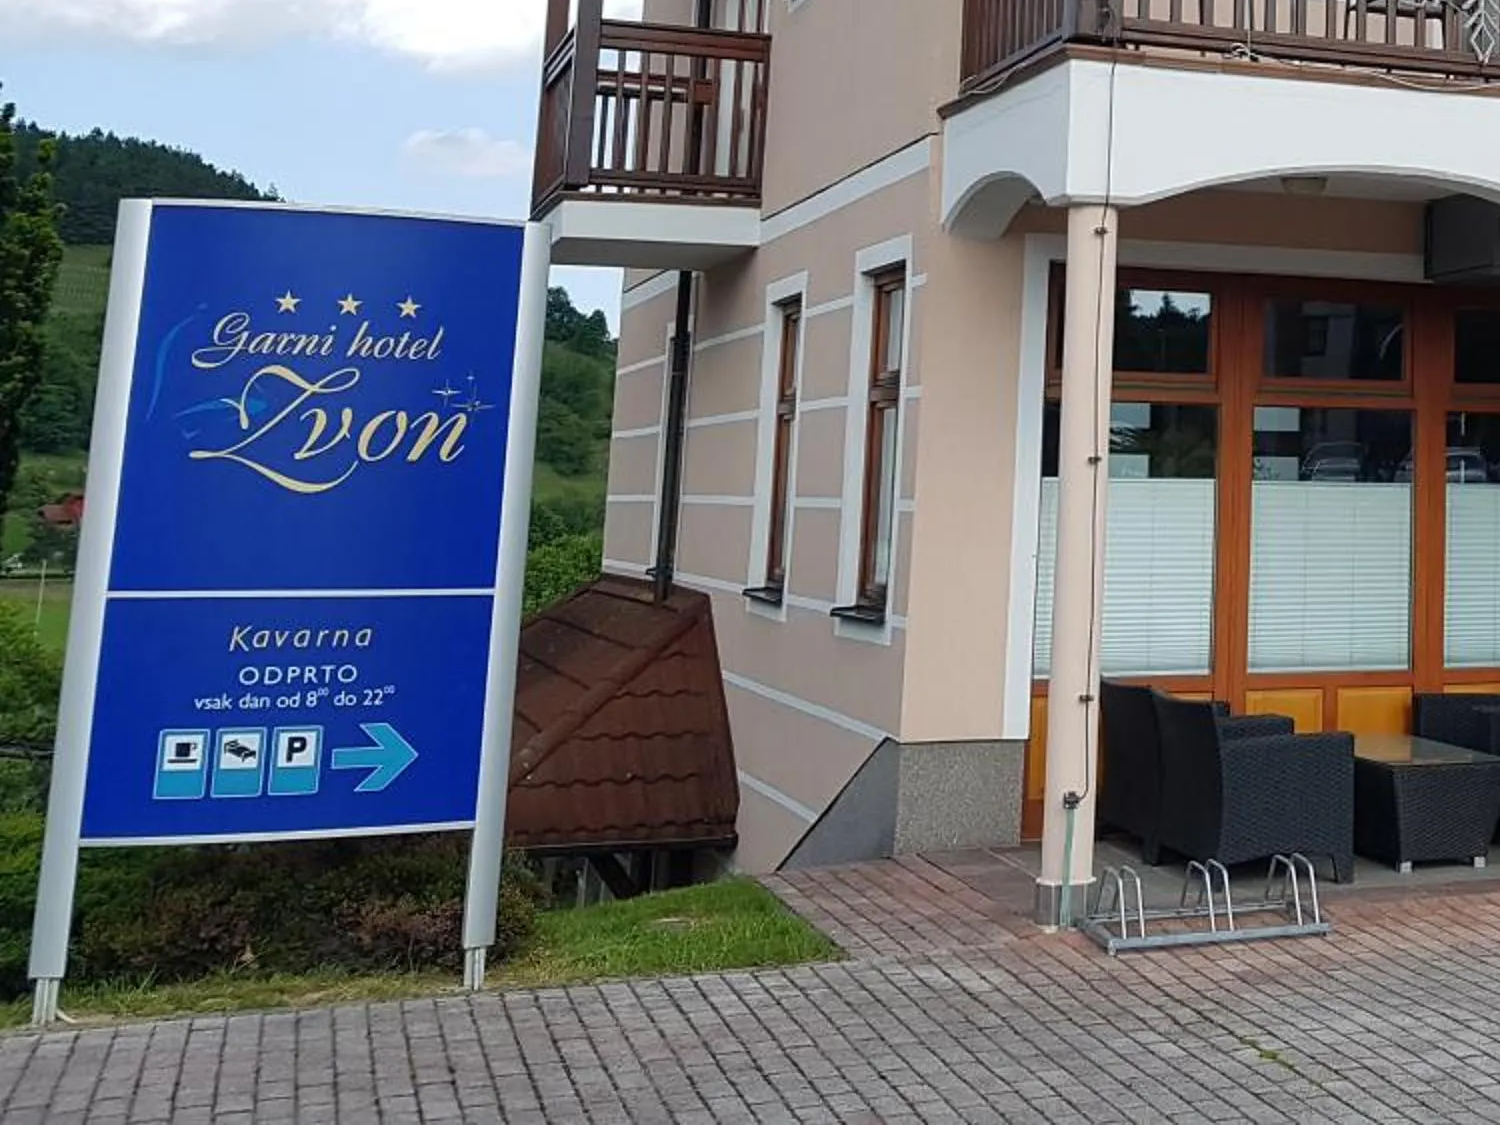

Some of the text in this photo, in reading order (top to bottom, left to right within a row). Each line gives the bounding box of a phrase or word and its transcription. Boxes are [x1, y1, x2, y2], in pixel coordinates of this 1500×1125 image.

[192, 312, 444, 367] Garni hotel
[189, 365, 467, 493] Zvon
[229, 626, 373, 651] Kavarna
[239, 665, 358, 685] ODPRTO
[194, 693, 232, 709] vsak
[239, 692, 270, 708] dan
[276, 691, 300, 708] od
[334, 690, 356, 706] do
